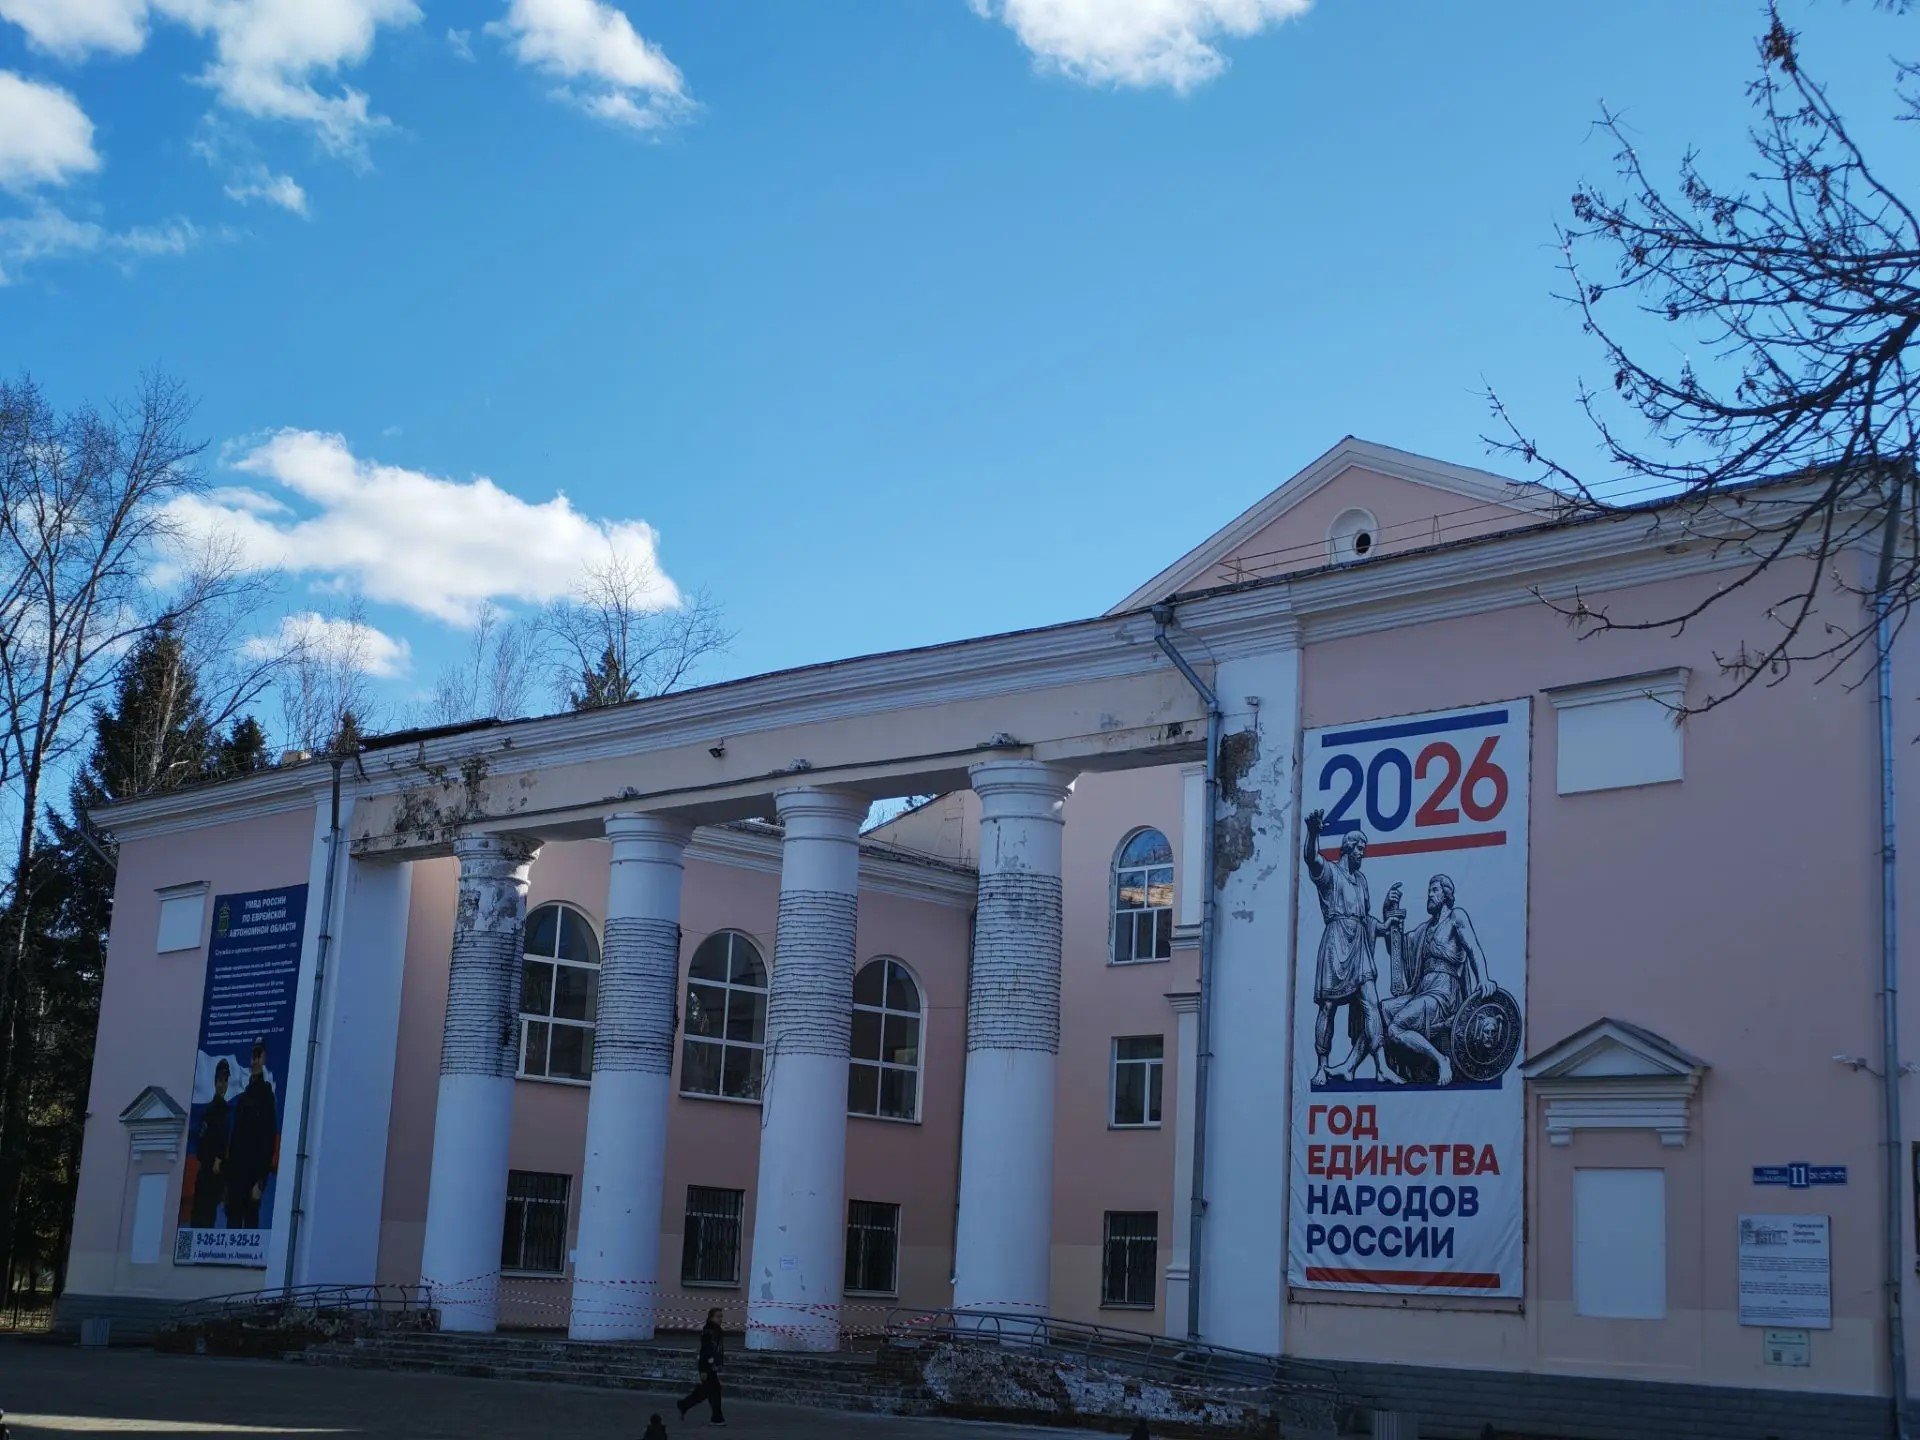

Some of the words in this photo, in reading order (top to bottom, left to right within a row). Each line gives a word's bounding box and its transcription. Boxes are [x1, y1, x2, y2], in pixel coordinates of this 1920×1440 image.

[1319, 735, 1508, 836] 2026
[242, 914, 250, 923] ПО
[251, 908, 287, 922] ЕВРЕЙСКОЙ
[245, 899, 261, 909] УМВД
[262, 896, 287, 907] РОССИИ
[229, 924, 269, 938] АВТОНОМНОЙ
[270, 921, 297, 934] ОБЛАСТИ
[1308, 1104, 1379, 1141] ГОД
[1307, 1143, 1501, 1181] ЕДИНСТВА
[1791, 1167, 1807, 1185] 11
[1306, 1184, 1480, 1222] НАРОДОВ
[1306, 1223, 1455, 1259] РОССИИ
